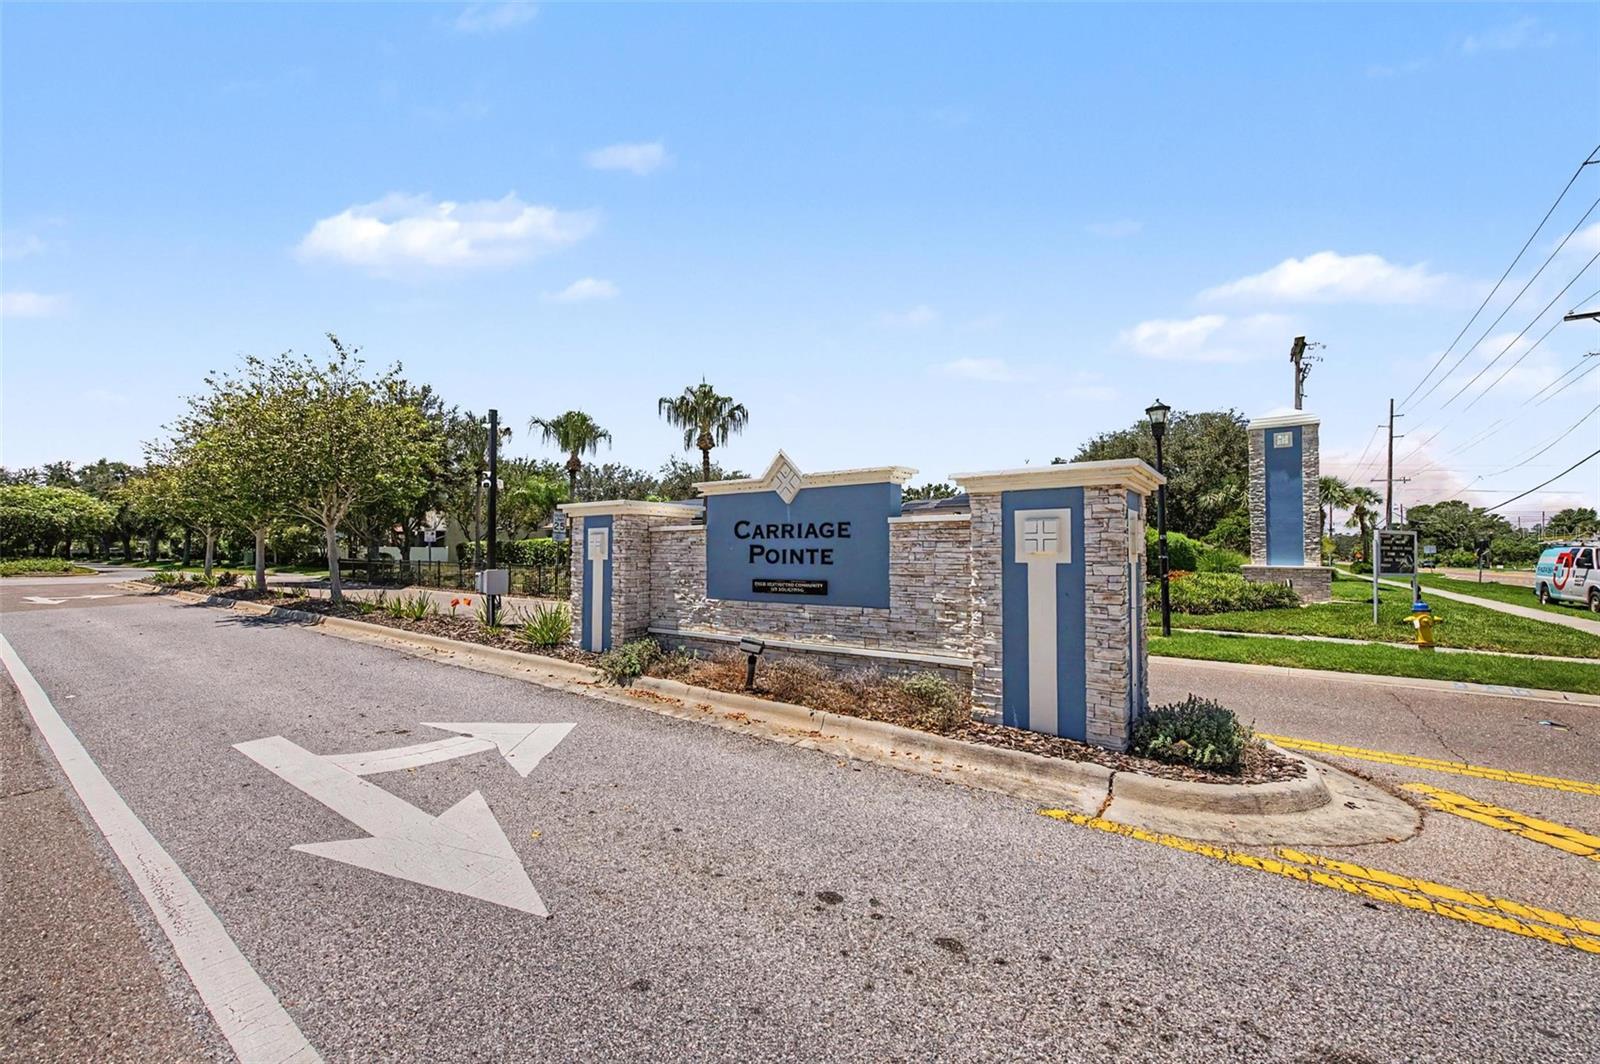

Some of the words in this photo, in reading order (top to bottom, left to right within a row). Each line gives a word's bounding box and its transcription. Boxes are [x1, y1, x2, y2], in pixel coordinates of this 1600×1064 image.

[554, 522, 565, 530] 25
[734, 520, 851, 540] CARRIAGE
[749, 544, 834, 565] POINTE
